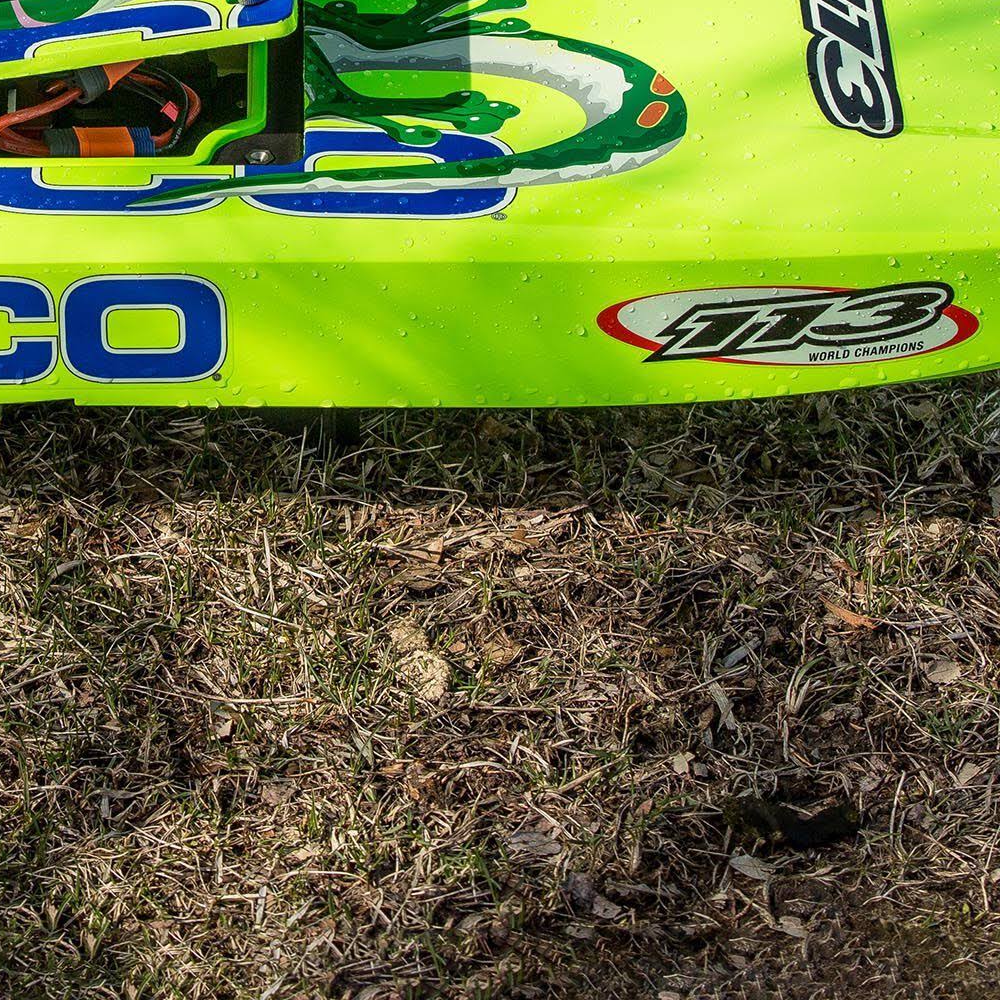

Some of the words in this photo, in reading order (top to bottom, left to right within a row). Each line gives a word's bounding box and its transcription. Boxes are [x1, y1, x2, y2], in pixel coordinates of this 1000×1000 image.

[641, 281, 956, 363] 113
[808, 350, 850, 363] WORLD
[854, 340, 925, 358] CHAMPIONS
